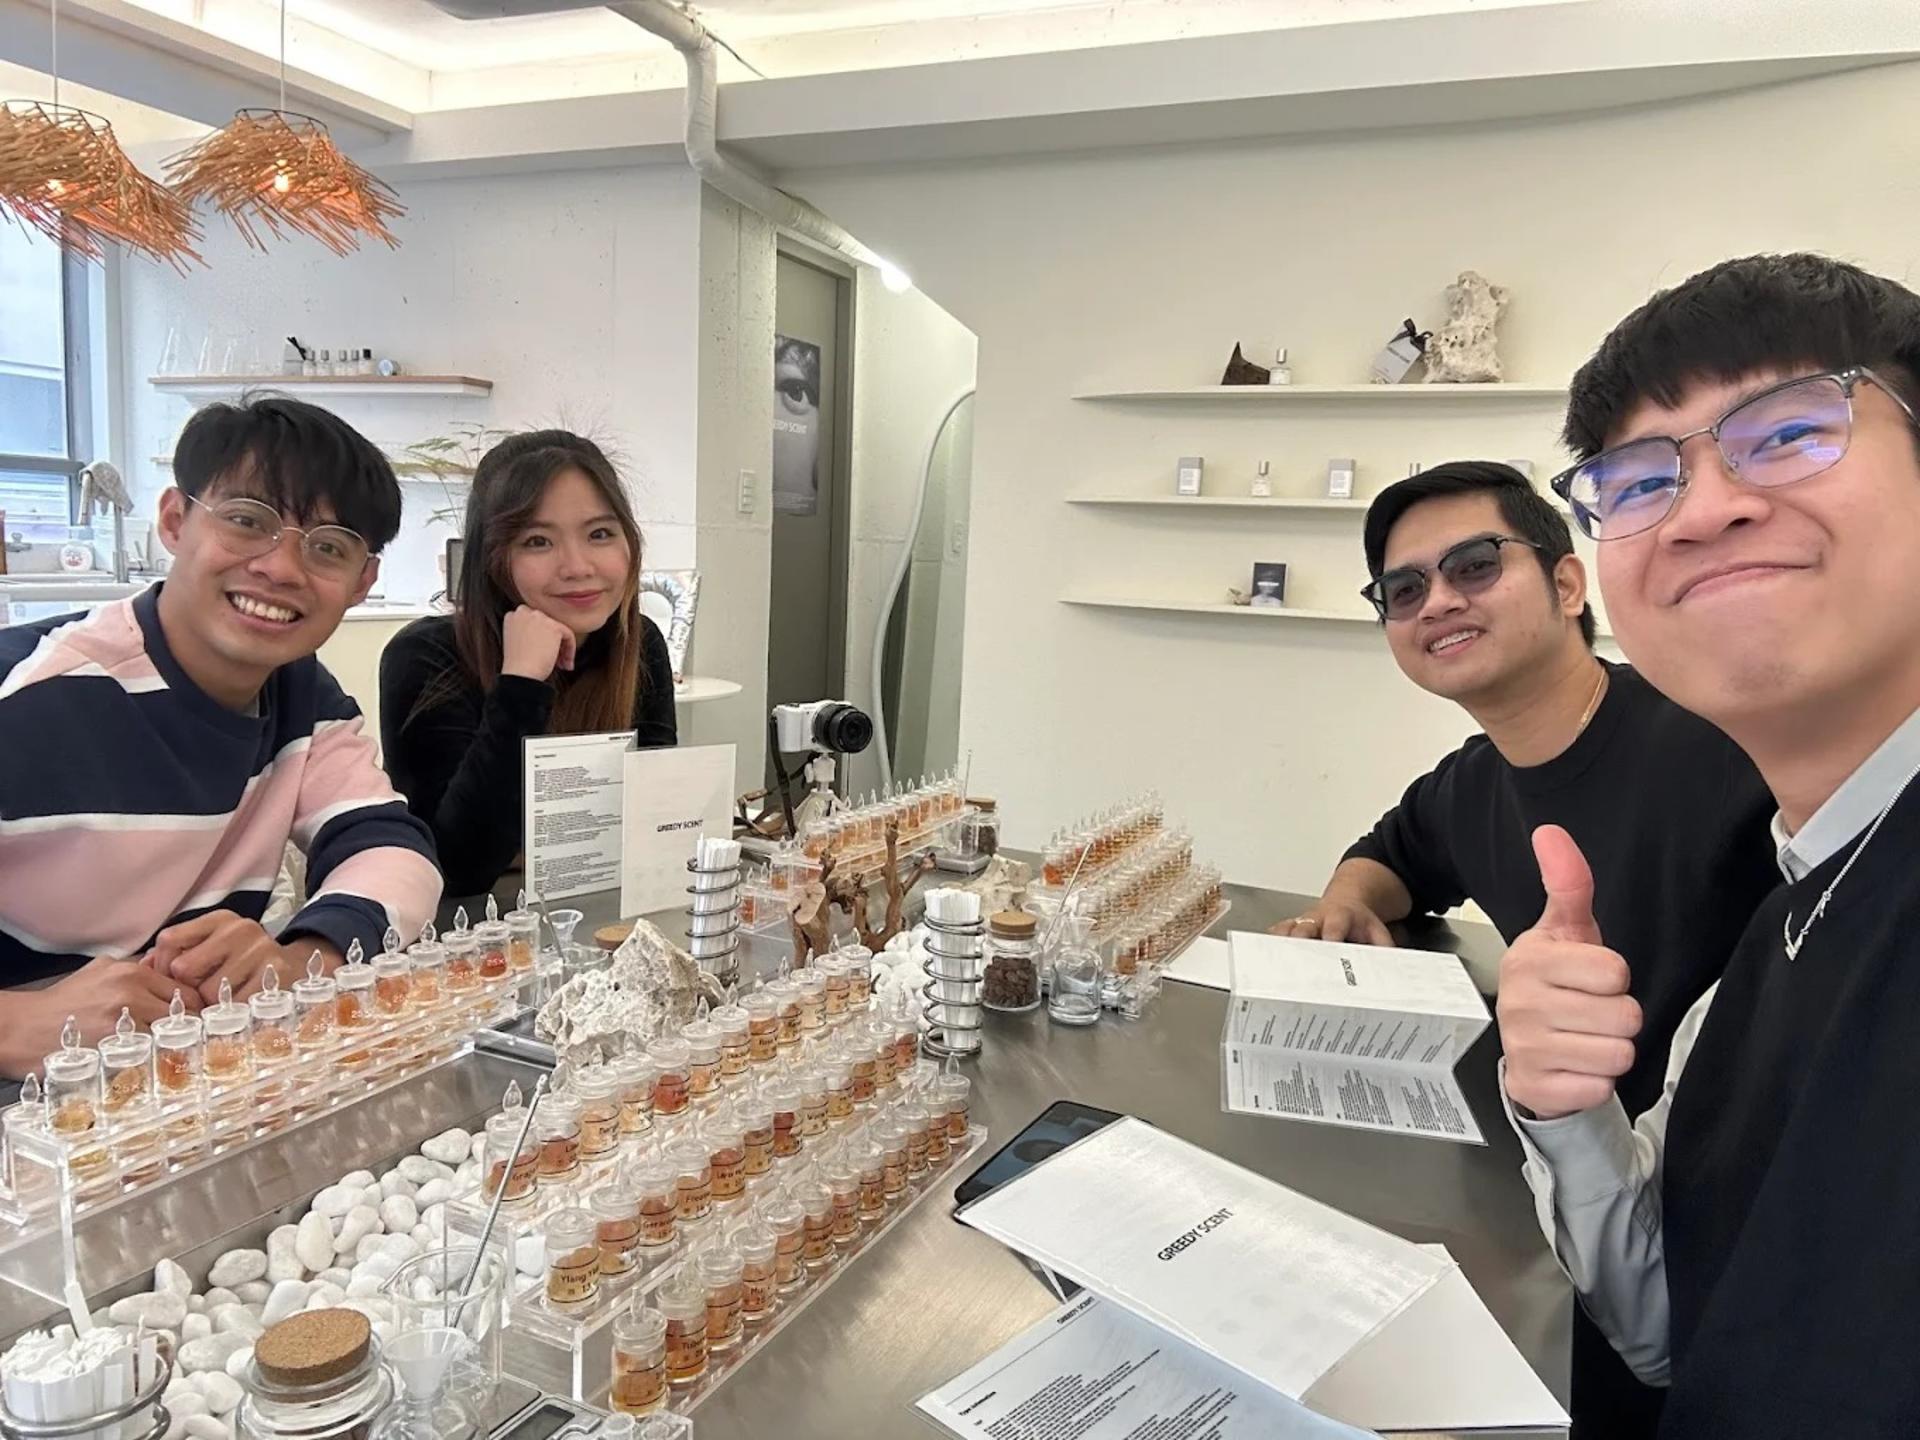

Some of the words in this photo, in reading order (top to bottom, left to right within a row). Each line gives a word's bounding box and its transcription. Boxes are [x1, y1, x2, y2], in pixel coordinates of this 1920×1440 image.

[656, 822, 682, 833] GREEDY
[682, 819, 704, 830] SCENT
[1157, 1228, 1203, 1261] GREEDY
[1197, 1207, 1234, 1233] SCENT
